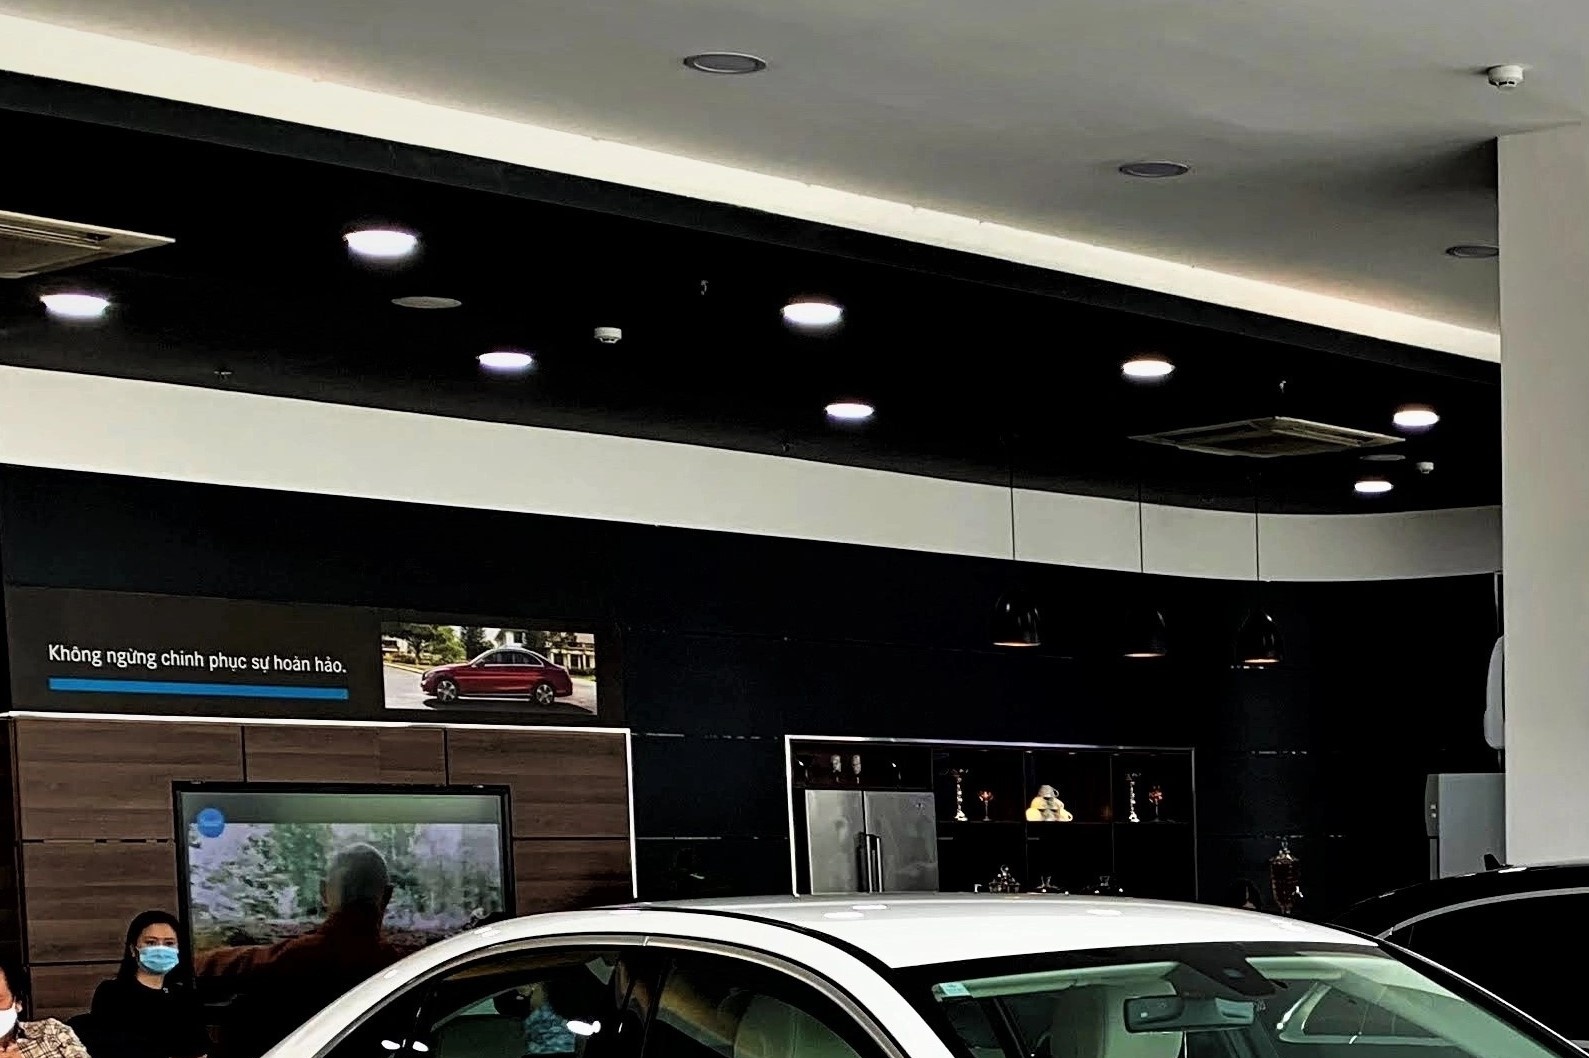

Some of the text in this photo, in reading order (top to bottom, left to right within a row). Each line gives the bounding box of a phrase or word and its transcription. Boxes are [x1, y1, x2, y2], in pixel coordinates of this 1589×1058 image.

[48, 644, 103, 667] Không
[106, 647, 158, 669] ngừng
[209, 651, 247, 672] phục
[251, 655, 270, 673] sự
